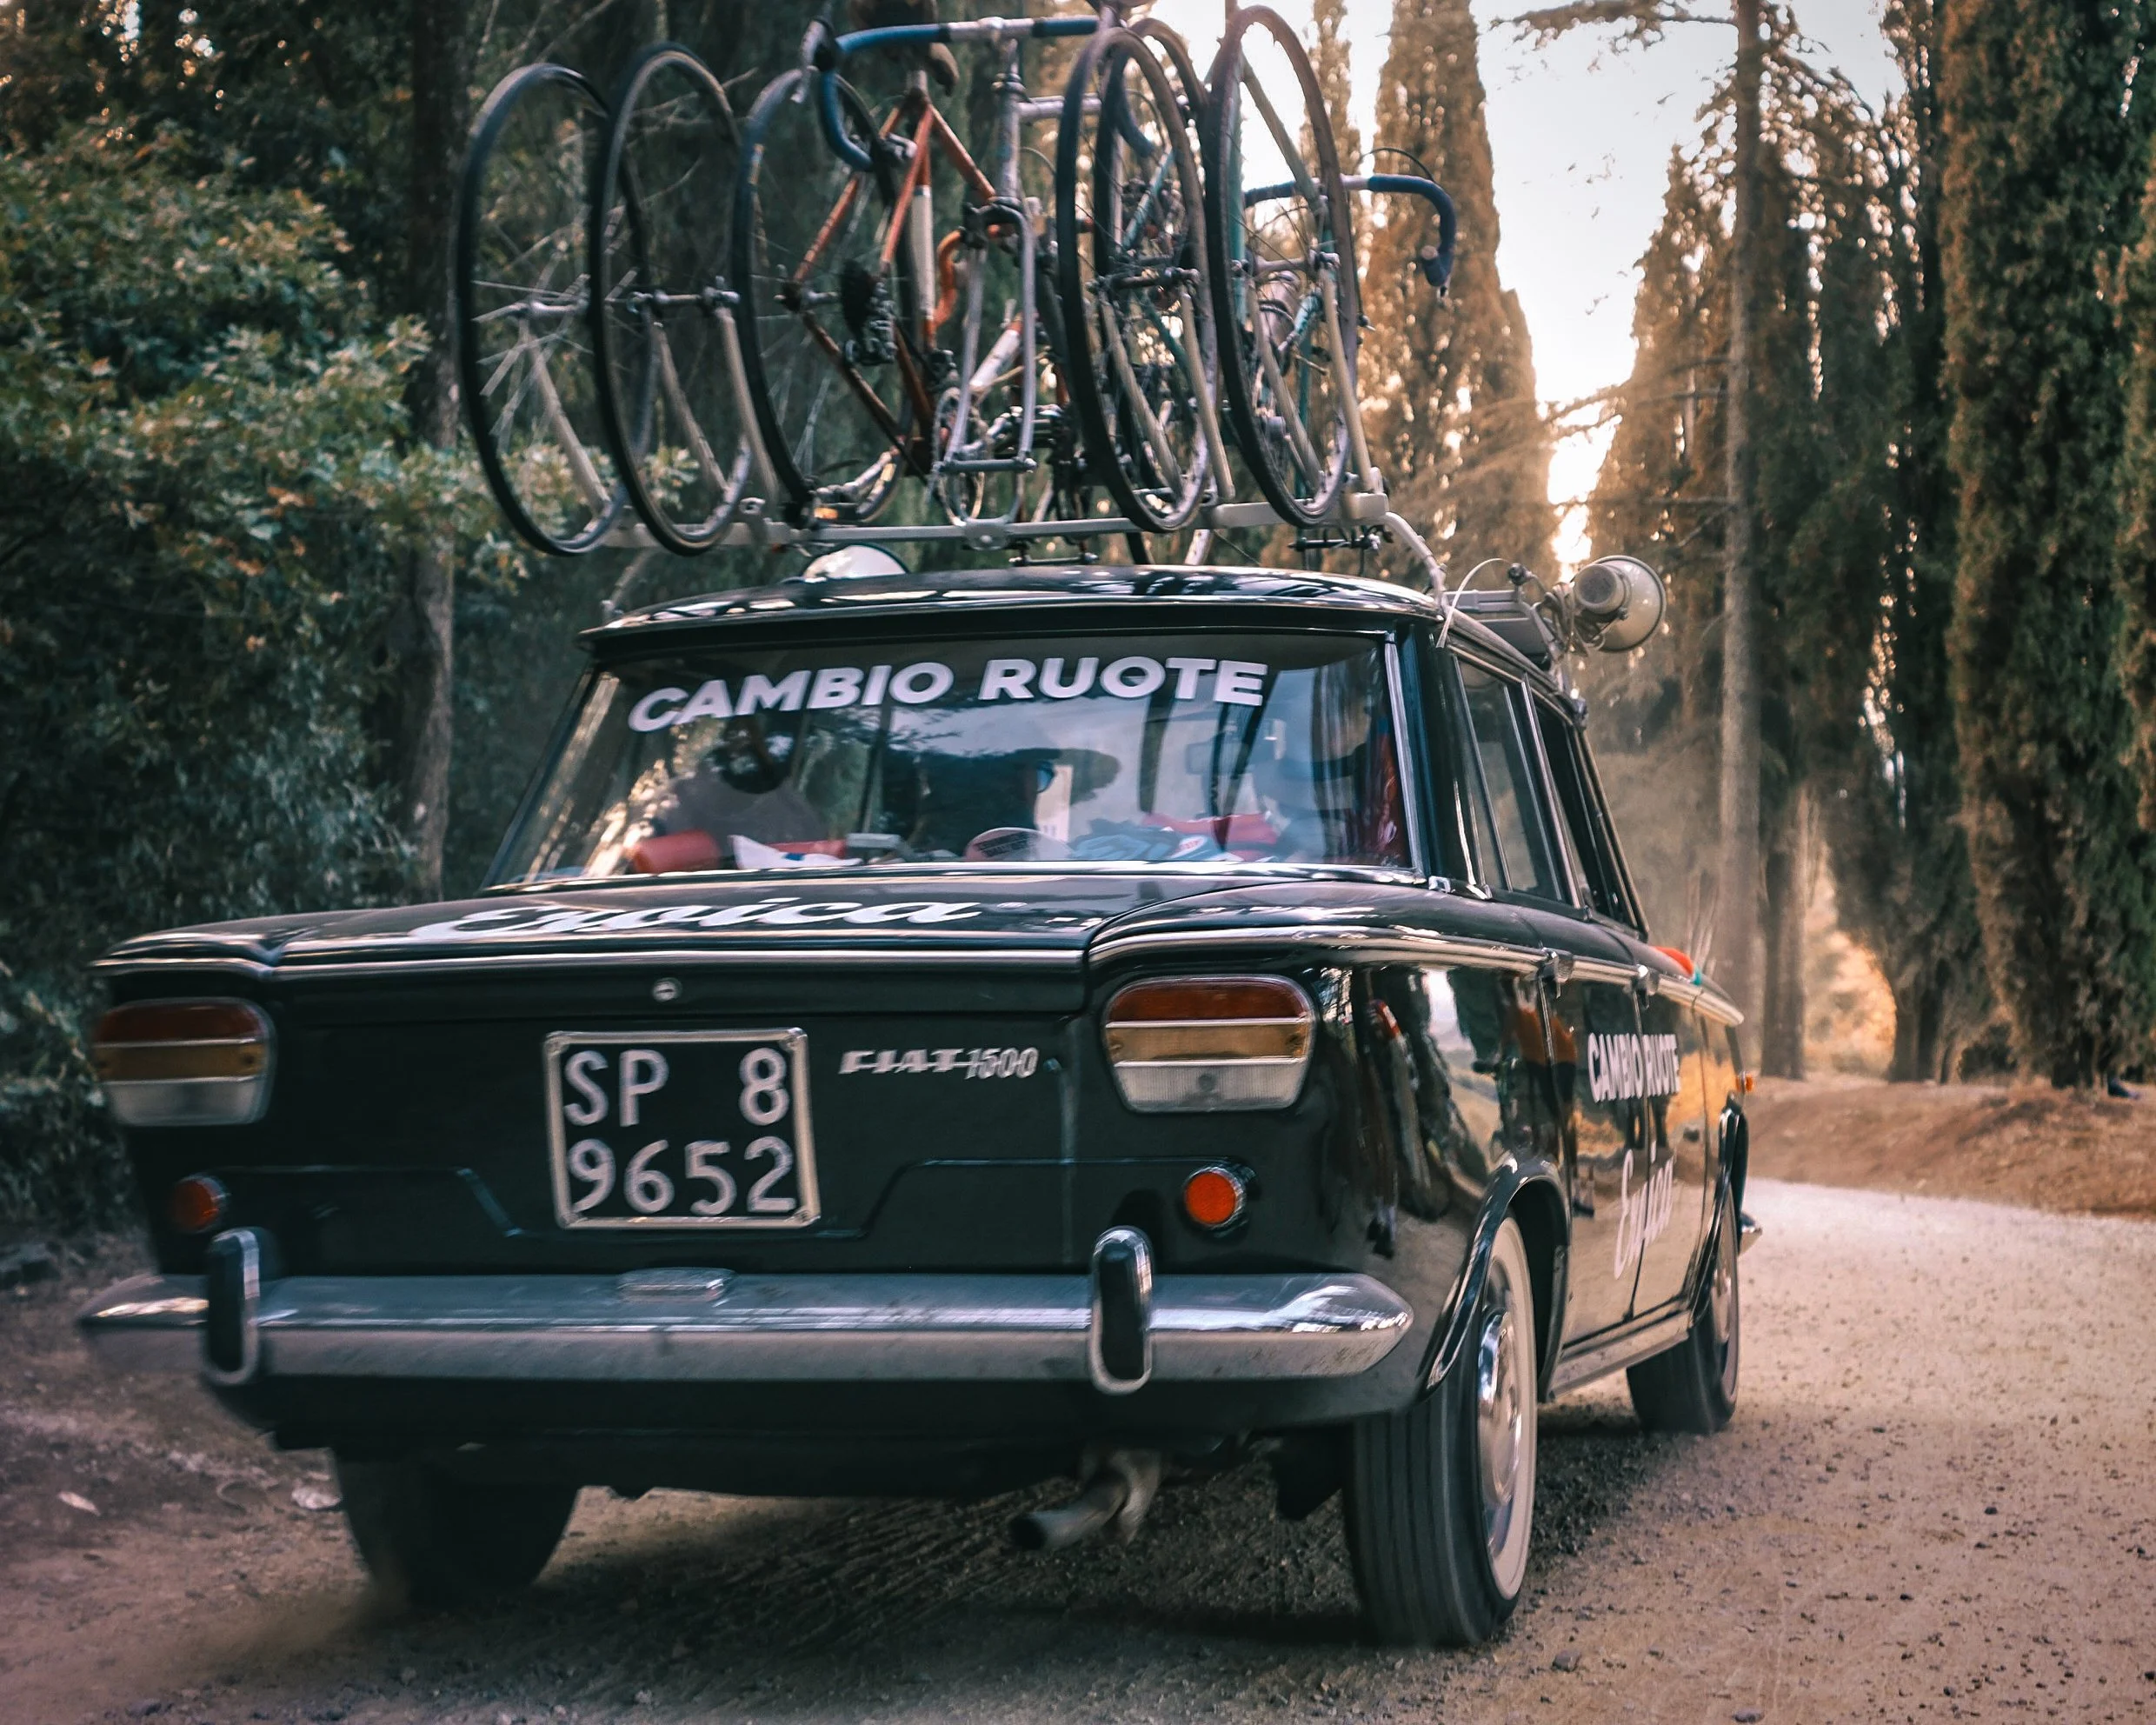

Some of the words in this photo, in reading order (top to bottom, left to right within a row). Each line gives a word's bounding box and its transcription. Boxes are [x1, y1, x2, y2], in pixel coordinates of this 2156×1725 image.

[629, 661, 953, 732] CAMBIO
[978, 656, 1268, 706] RUOTE
[407, 897, 983, 939] Eroica
[564, 1049, 669, 1127] SP
[739, 1047, 789, 1126] 8
[838, 1048, 965, 1075] FIAT
[964, 1046, 1040, 1080] 1500
[1587, 1032, 1644, 1103] CAMBIO
[567, 1136, 796, 1215] 9652
